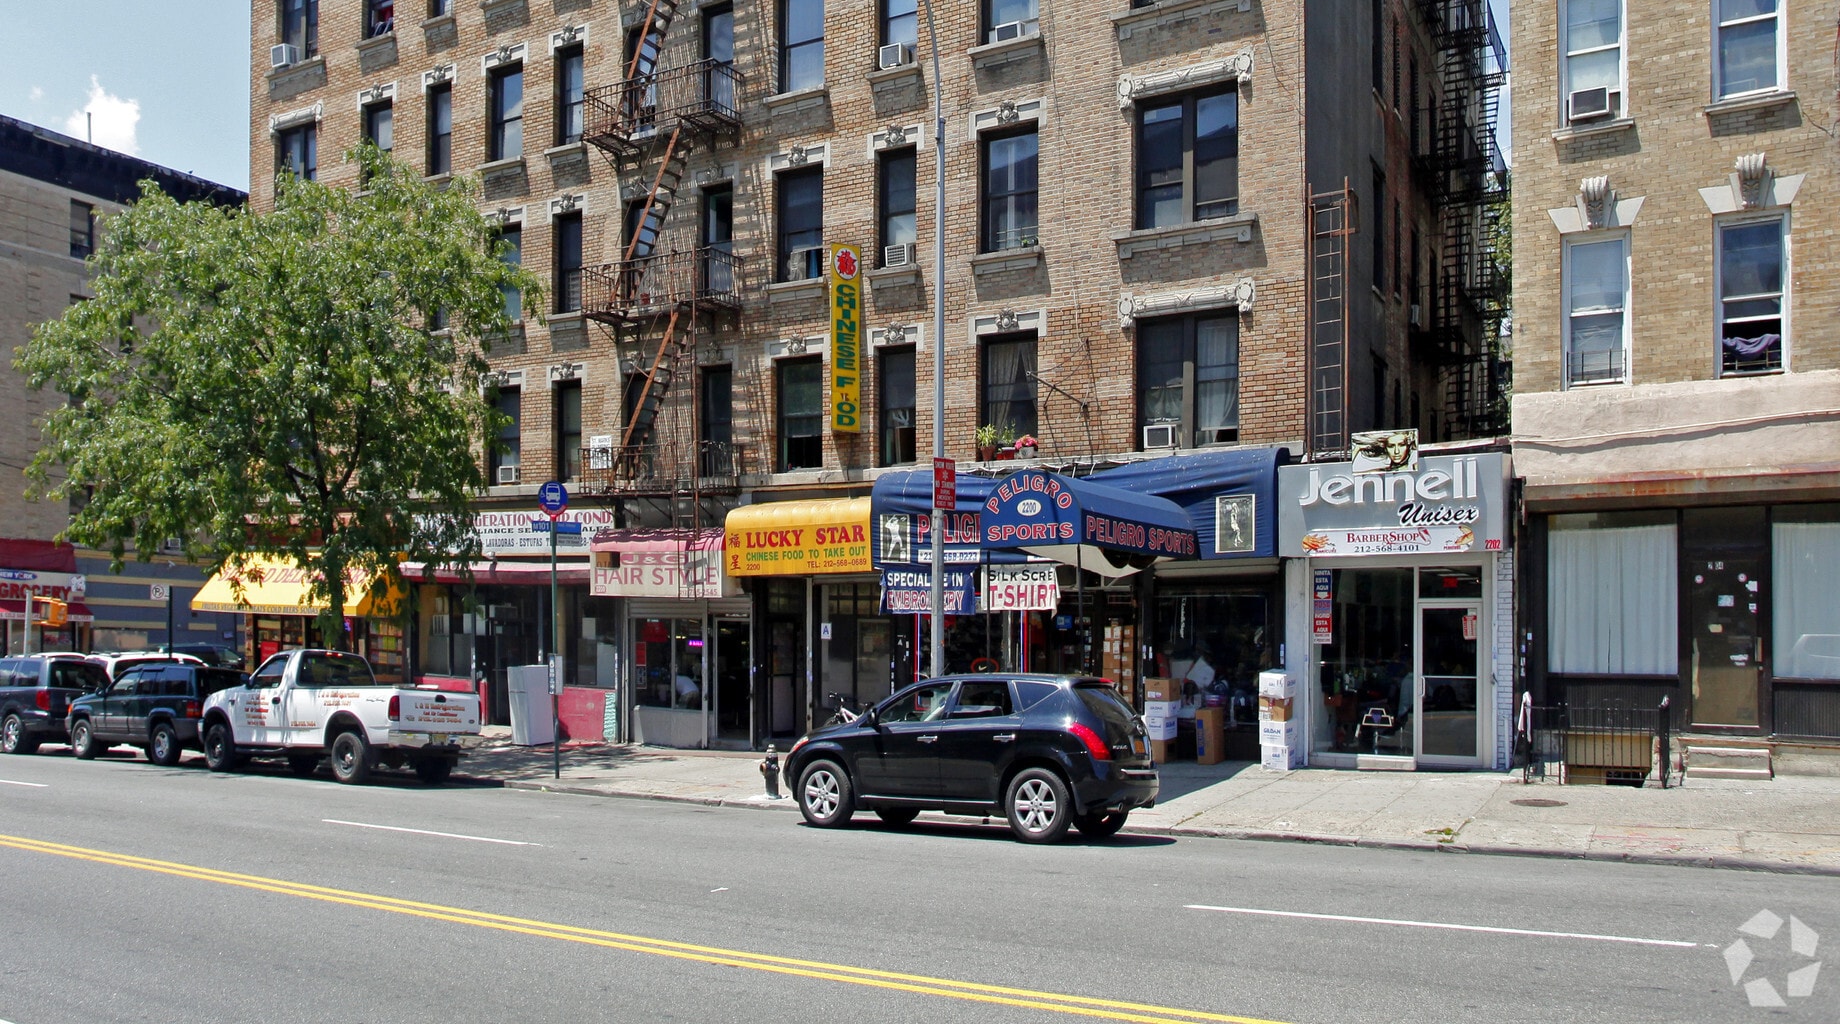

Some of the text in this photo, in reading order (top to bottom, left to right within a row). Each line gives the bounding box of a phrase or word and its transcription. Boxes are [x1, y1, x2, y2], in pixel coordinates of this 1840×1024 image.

[836, 283, 856, 371] CHINESE
[1299, 458, 1477, 505] Jennell
[987, 475, 1072, 514] PELIGRO
[1022, 502, 1036, 513] 2200
[1399, 503, 1478, 525] Unisex
[533, 521, 549, 530] M101
[987, 522, 1074, 542] SPORTS
[486, 538, 515, 547] LAVADORAS
[520, 538, 543, 547] ESTUFAS
[746, 525, 866, 549] LUCKY STAR
[1086, 515, 1195, 555] PELIGRO SPORTS
[1354, 544, 1419, 553] 212-568-4101
[1485, 540, 1500, 550] 2202
[622, 554, 685, 565] J&G
[746, 546, 866, 561] CHINESE FOOD TO TAKE OUT
[807, 560, 821, 568] TEL:
[823, 559, 867, 568] 212-568-0689
[595, 567, 717, 586] HAIR STYLE
[952, 572, 963, 587] IN
[0, 582, 71, 601] GROCERY
[283, 606, 299, 614] BEERS
